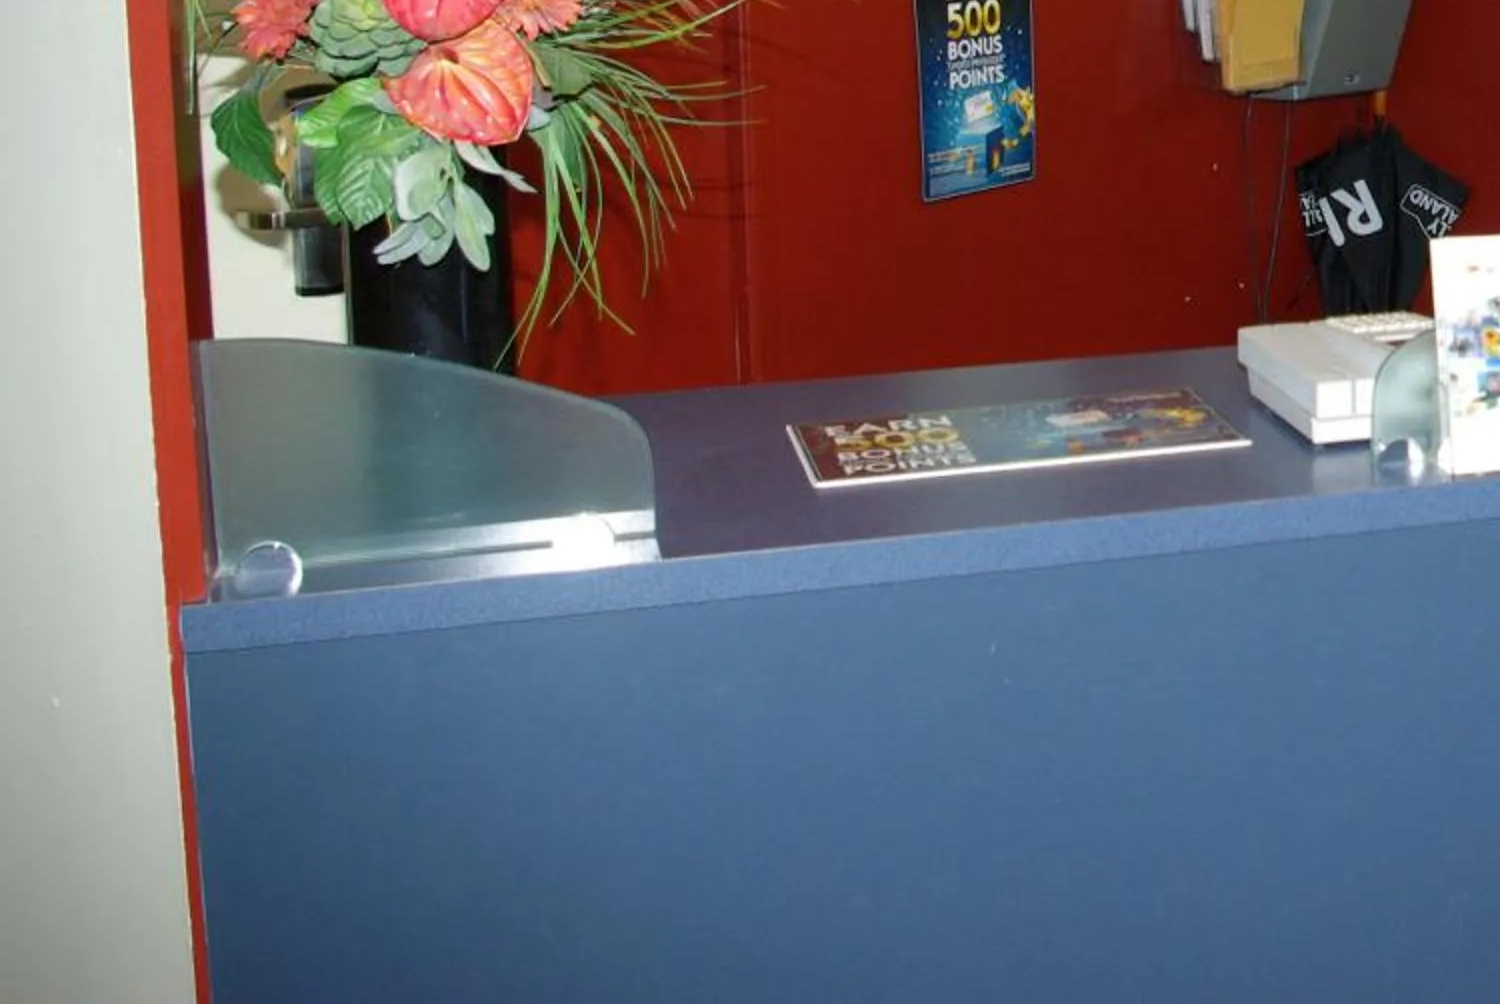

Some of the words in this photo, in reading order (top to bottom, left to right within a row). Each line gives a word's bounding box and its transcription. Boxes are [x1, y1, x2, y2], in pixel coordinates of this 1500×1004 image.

[947, 36, 1003, 62] BONUS
[950, 65, 1006, 91] POINTS
[825, 414, 953, 438] EARN
[834, 427, 959, 450] 500
[837, 442, 967, 462] BONUS
[843, 451, 977, 476] POINTS
